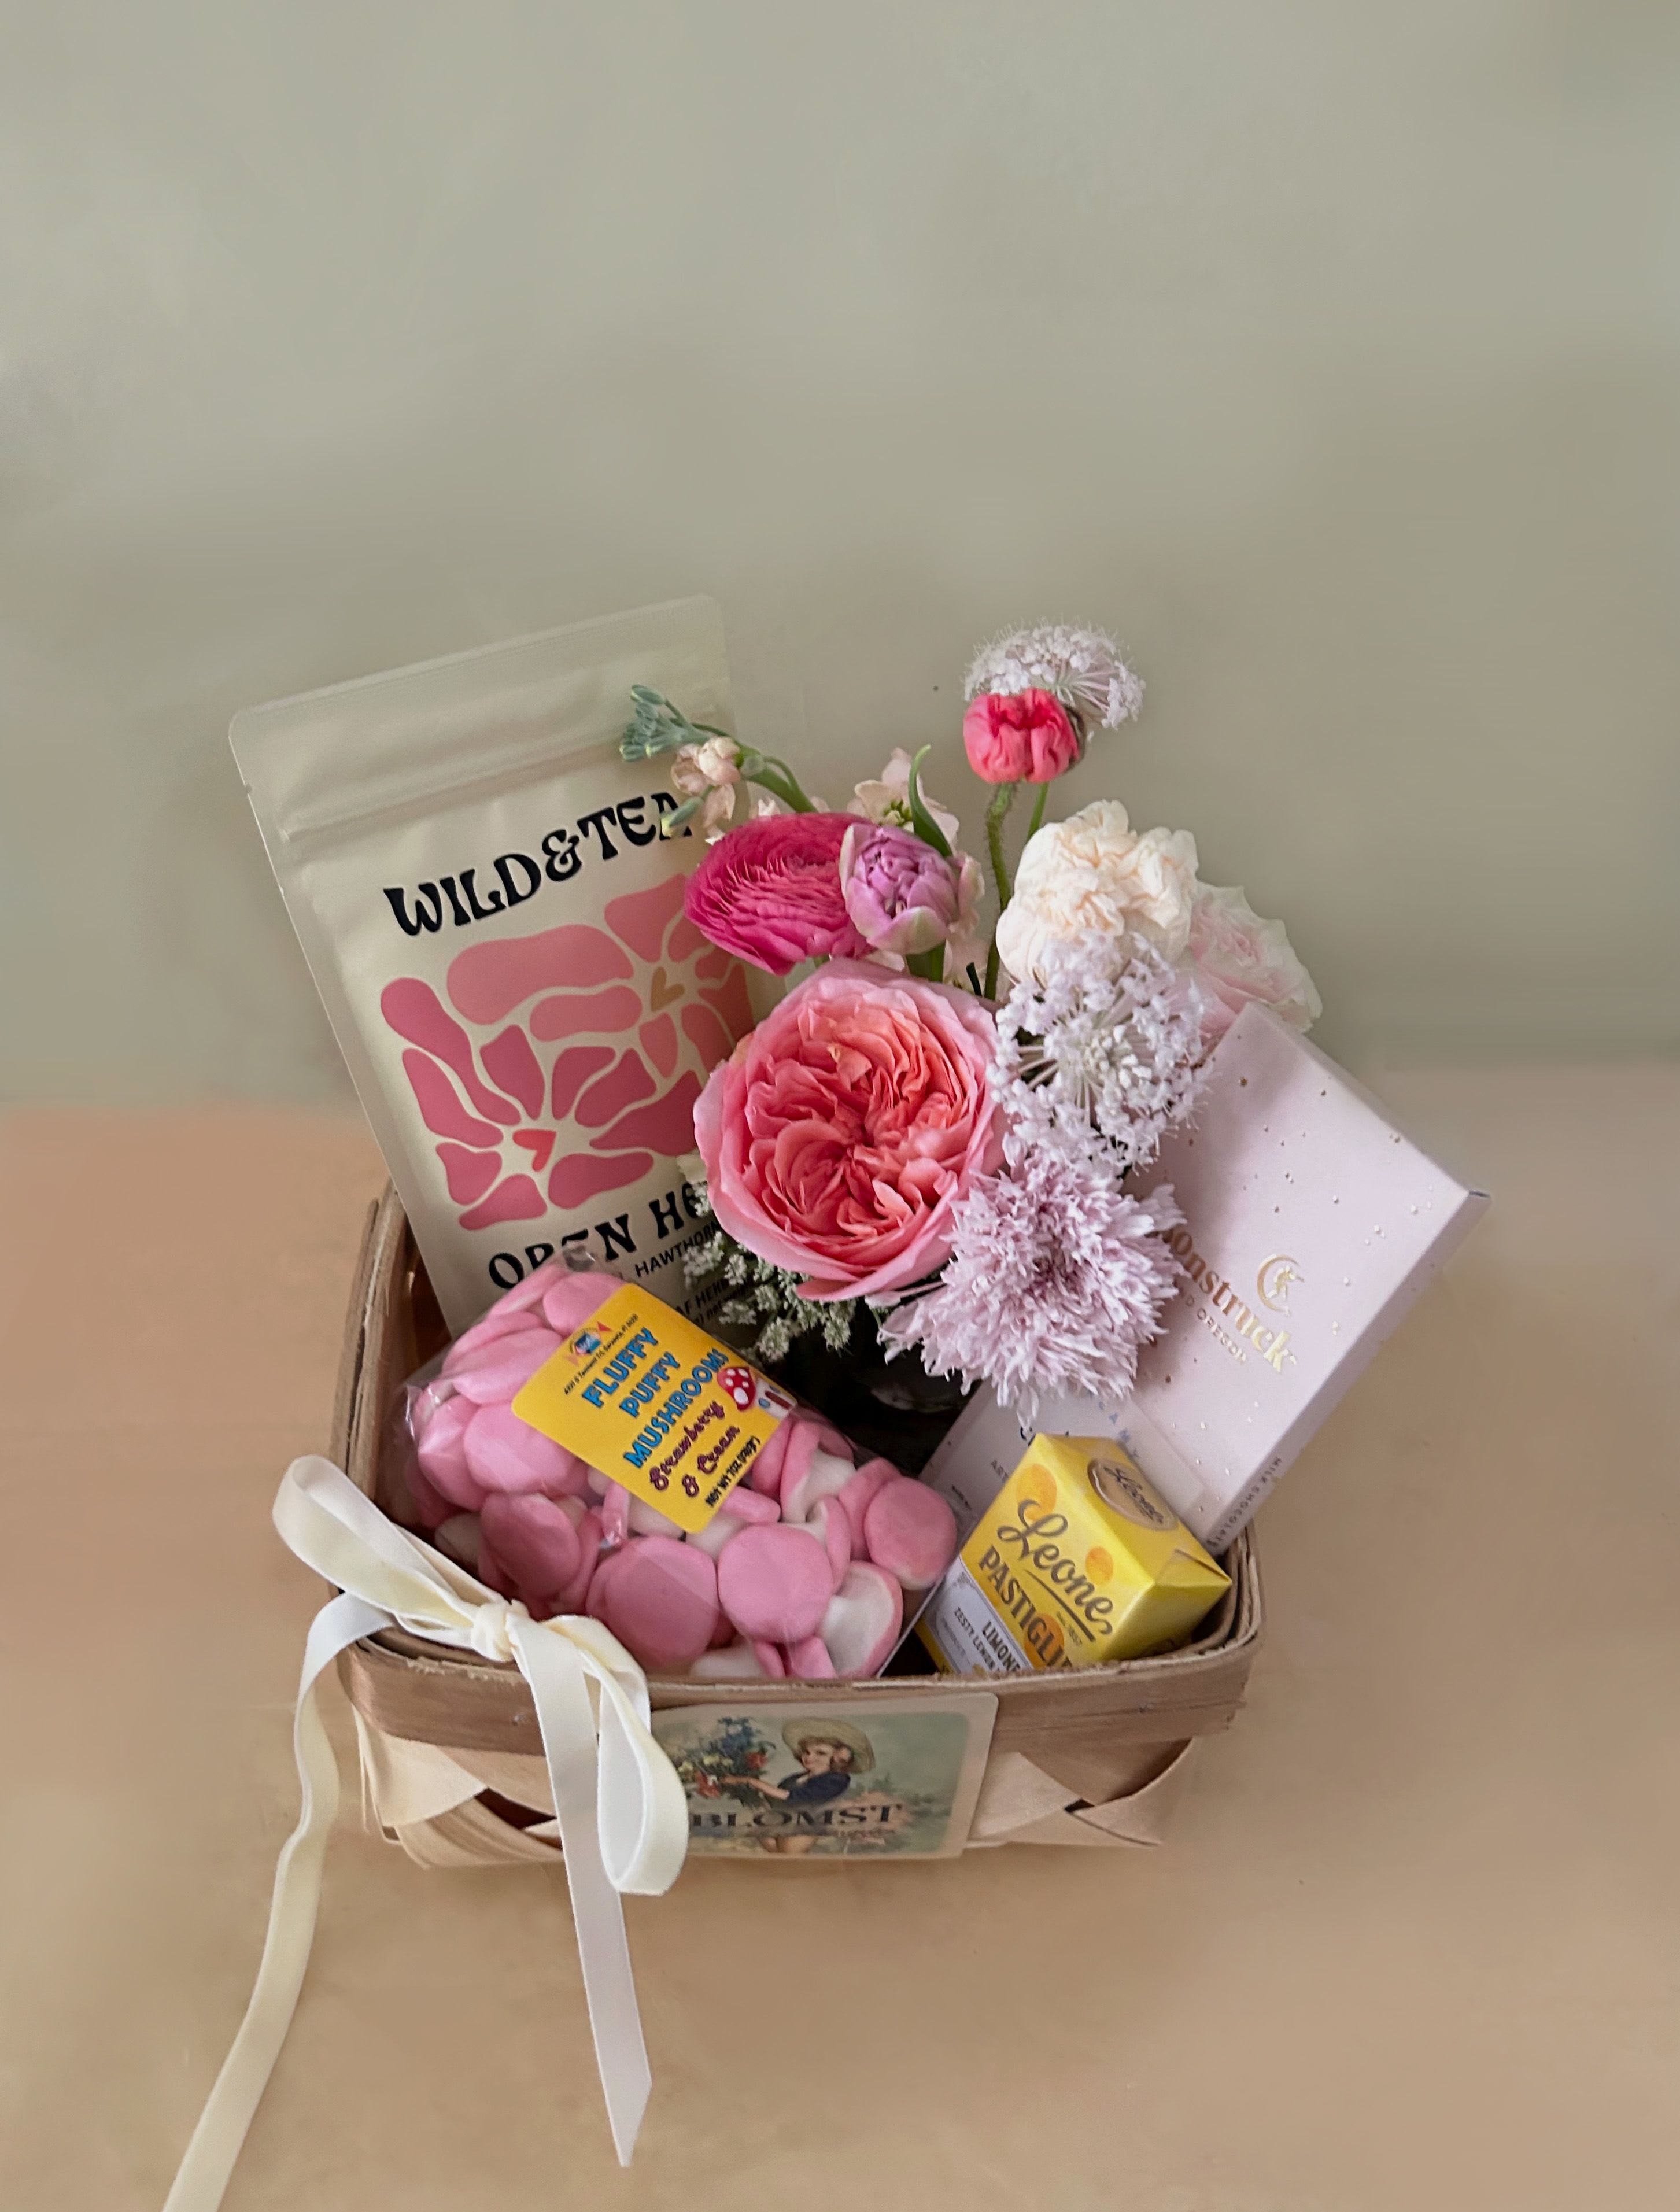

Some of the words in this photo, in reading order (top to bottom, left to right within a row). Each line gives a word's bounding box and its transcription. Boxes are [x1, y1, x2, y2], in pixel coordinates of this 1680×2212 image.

[581, 1327, 659, 1409] FLUFFY
[1197, 1308, 1247, 1365] OREGON
[619, 1351, 681, 1418] PUFFY
[622, 1347, 730, 1469] MUSHROOMS
[649, 1400, 725, 1491] Strawberry
[696, 1425, 740, 1475] Cream
[996, 1498, 1113, 1635] Leone
[954, 1607, 976, 1639] ZESTY
[972, 1633, 996, 1670] LEMON
[691, 1804, 903, 1827] BLOMST
